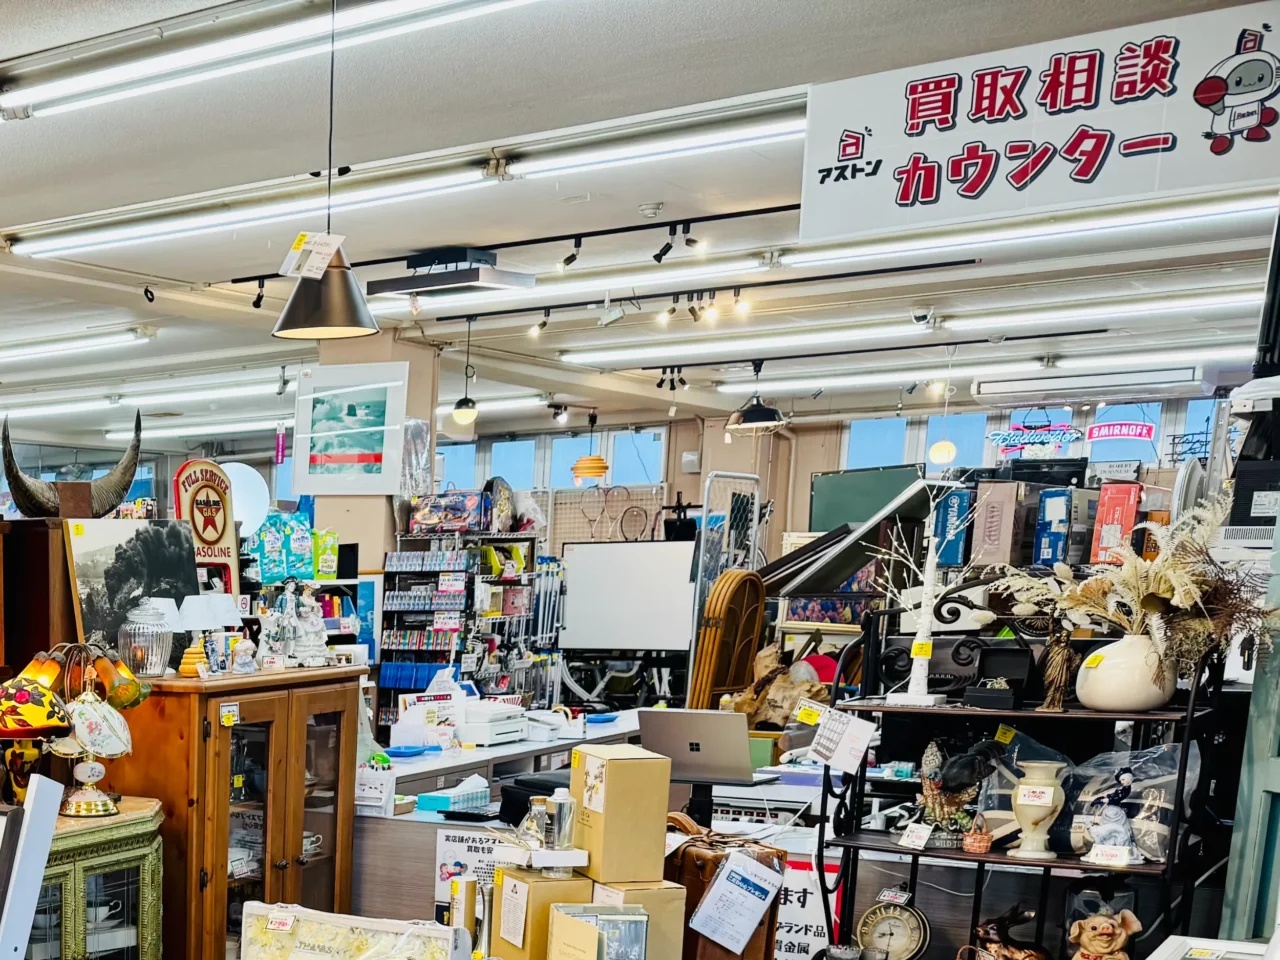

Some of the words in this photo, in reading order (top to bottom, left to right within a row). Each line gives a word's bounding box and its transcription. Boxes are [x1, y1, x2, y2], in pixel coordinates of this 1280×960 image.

[904, 35, 1180, 136] 買取相談
[818, 159, 883, 185] アストン
[893, 124, 1177, 207] カウンター
[988, 429, 1082, 446] Budweiser
[1092, 424, 1148, 438] SMIRNOFF
[181, 470, 200, 493] FULL
[200, 468, 229, 496] SERVICE
[202, 508, 216, 517] GAS
[195, 546, 231, 558] ASOLINE
[935, 840, 952, 848] WILD
[876, 906, 886, 916] 11
[890, 906, 900, 915] 12
[865, 914, 875, 924] 10
